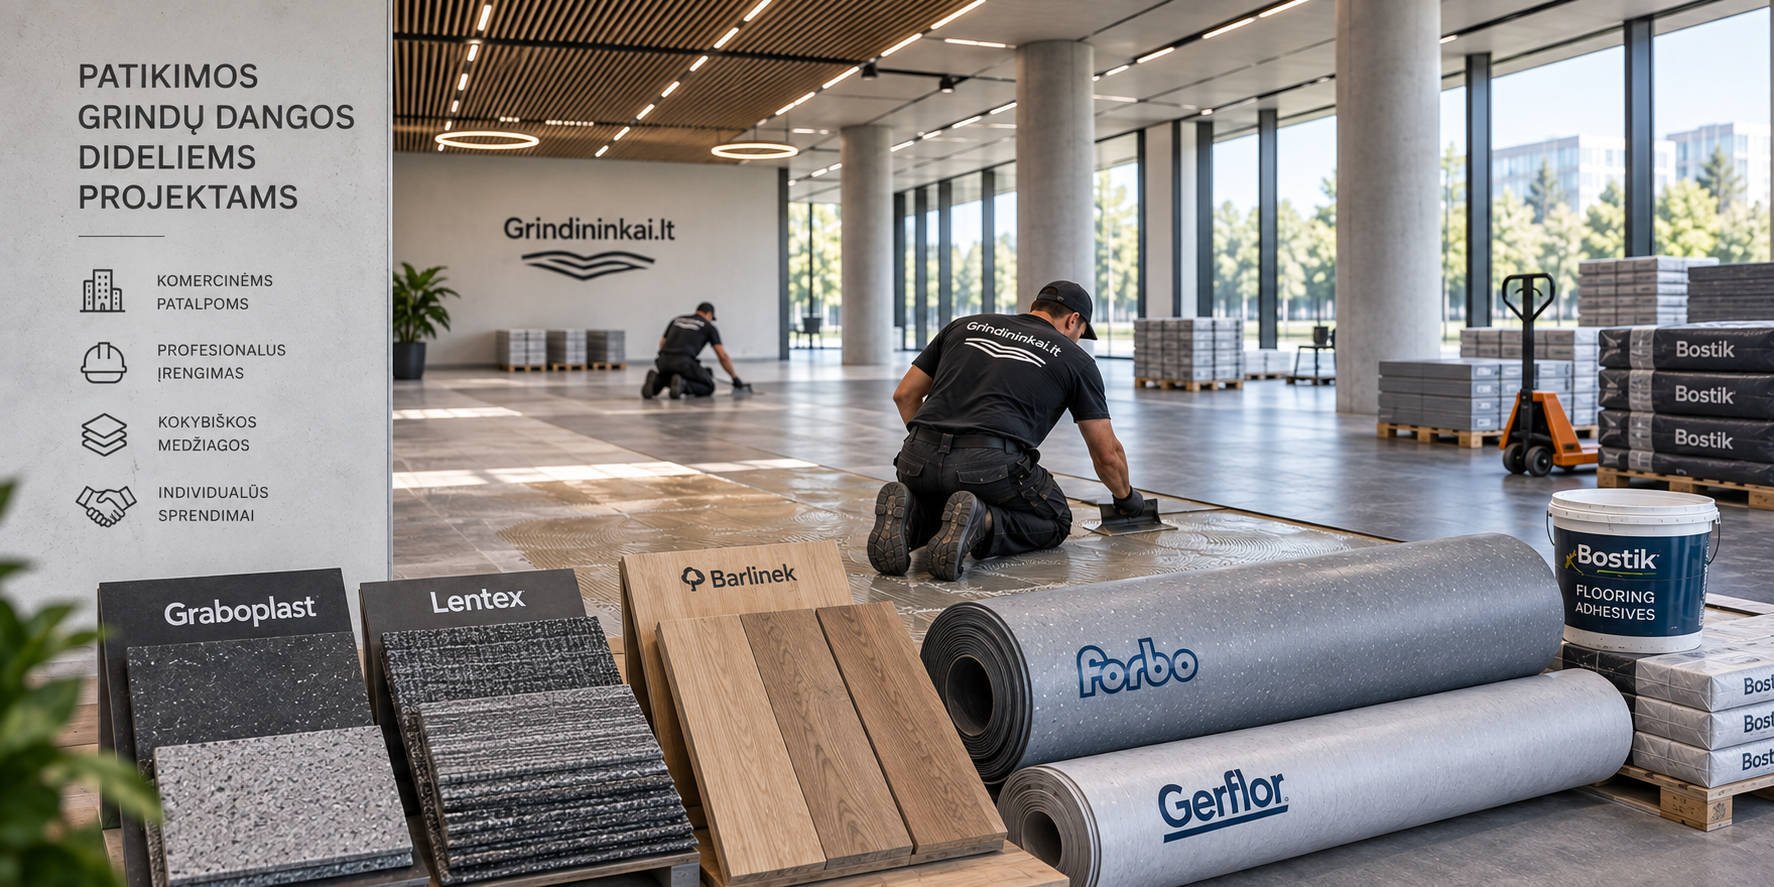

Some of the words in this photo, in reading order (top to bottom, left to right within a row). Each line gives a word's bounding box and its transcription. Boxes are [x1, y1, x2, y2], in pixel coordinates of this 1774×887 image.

[79, 63, 258, 89] PATIKIMOS
[78, 104, 204, 136] GRINDŲ
[216, 104, 355, 130] DANGOS
[79, 144, 256, 170] DIDELIEMS
[79, 184, 298, 210] PROJEKTAMS
[503, 216, 676, 241] Grindininkai.lt
[157, 272, 273, 287] KOMERCINĖMS
[157, 297, 249, 311] PATALPOMS
[157, 343, 287, 357] PROFESIONALUS
[1676, 340, 1735, 358] Bostik
[157, 366, 245, 383] ĮRENGIMAS
[1675, 384, 1734, 405] Bostik
[158, 412, 257, 429] KOKYBIŠKOS
[158, 436, 250, 452] MEDŽIAGOS
[1675, 428, 1734, 450] Bostik
[158, 509, 254, 522] SPRENDIMAI
[1577, 543, 1657, 570] Bostik
[710, 563, 798, 589] Barlinek
[429, 587, 526, 614] Lentex
[1576, 584, 1655, 604] FLOORING
[164, 595, 317, 628] Graboplast
[1574, 601, 1656, 621] ADHESIVES
[1157, 768, 1284, 828] Gerflor
